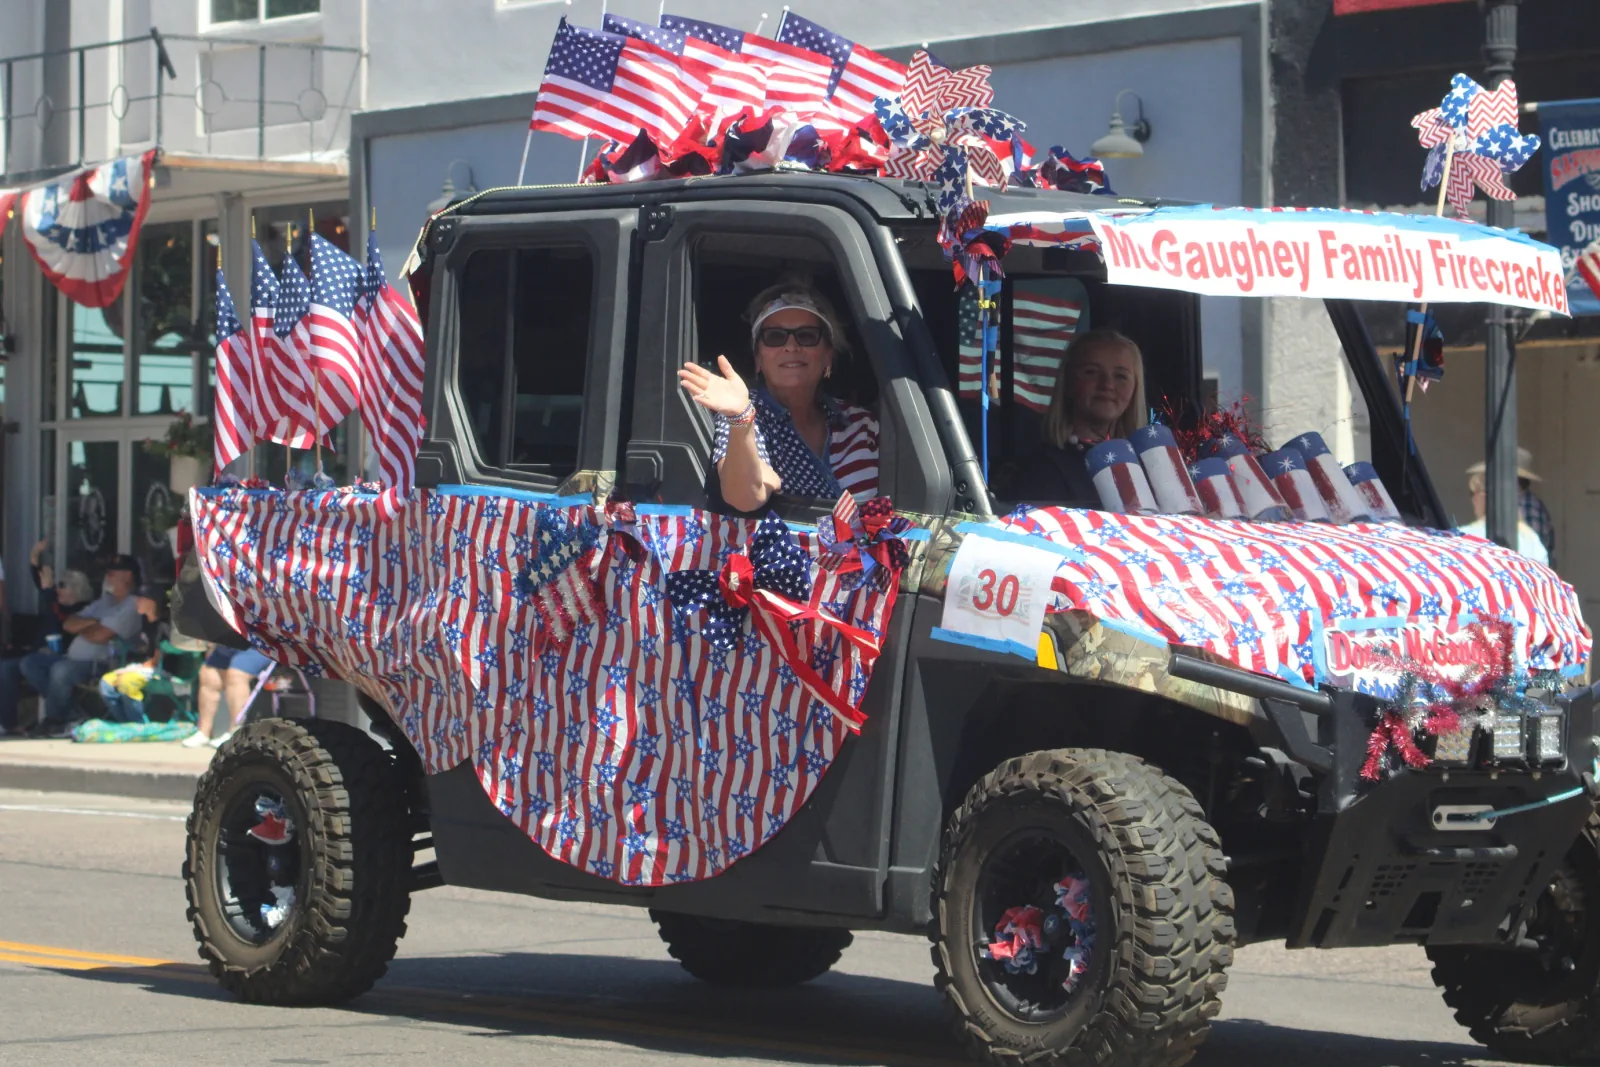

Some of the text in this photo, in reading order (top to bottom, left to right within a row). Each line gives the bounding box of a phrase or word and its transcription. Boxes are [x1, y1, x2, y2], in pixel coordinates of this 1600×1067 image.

[1101, 224, 1310, 293] McGaughey
[1318, 229, 1423, 299] Family
[973, 569, 1019, 616] 30
